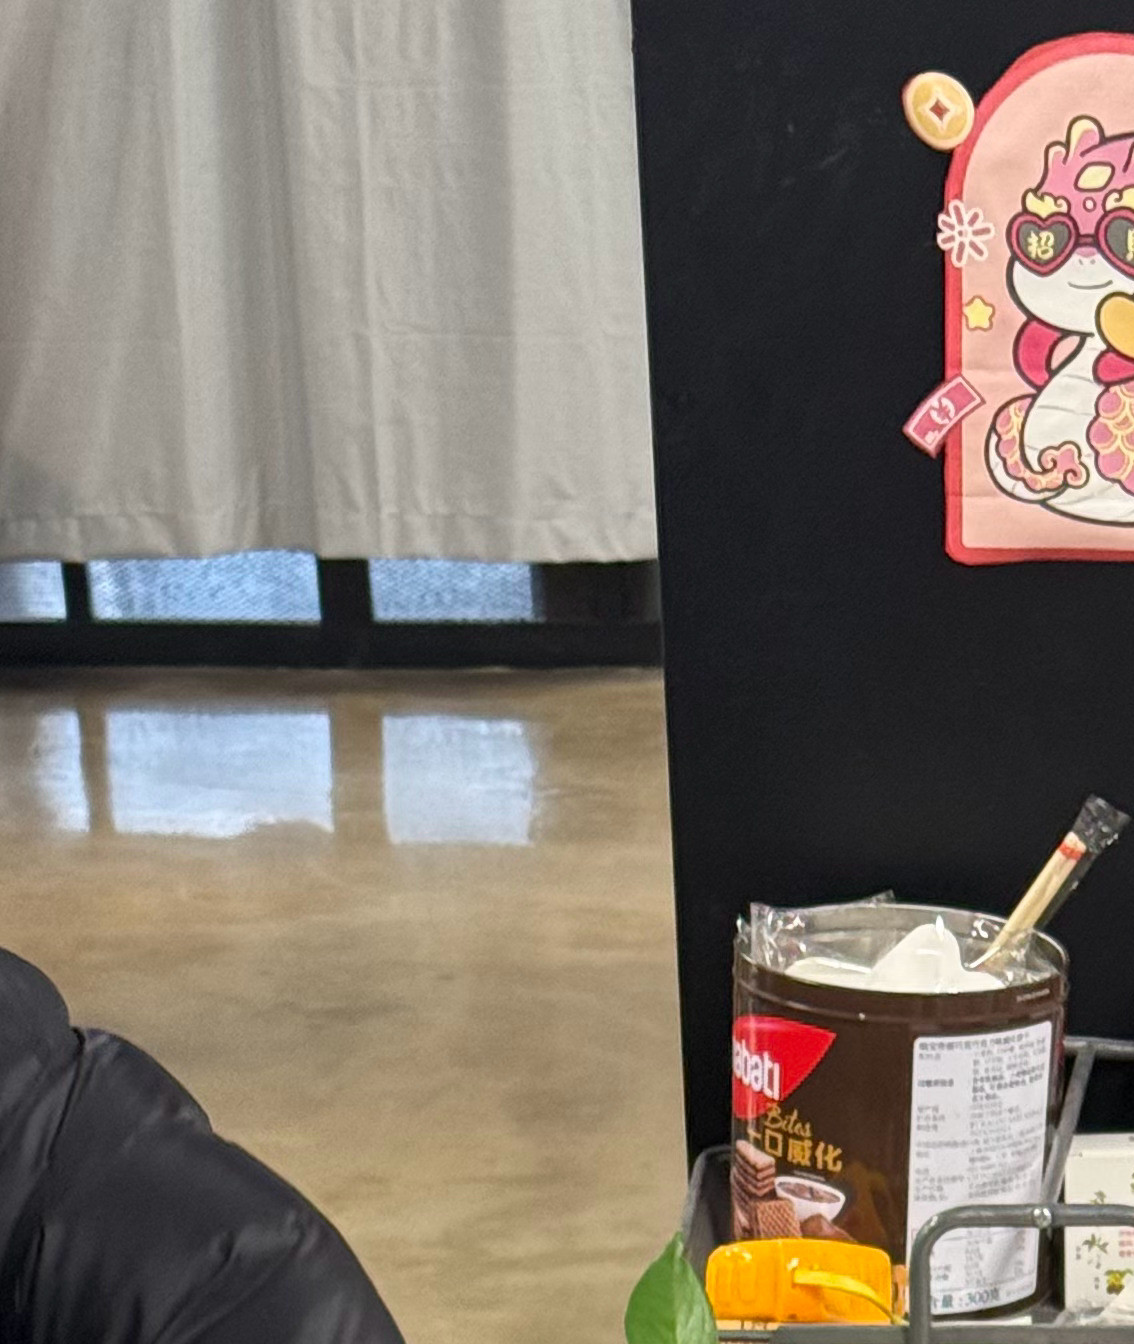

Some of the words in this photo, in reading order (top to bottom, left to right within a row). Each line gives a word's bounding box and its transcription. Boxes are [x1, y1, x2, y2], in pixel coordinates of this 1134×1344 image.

[1026, 230, 1055, 260] 招
[732, 1036, 780, 1101] abati
[764, 1103, 812, 1137] Bites
